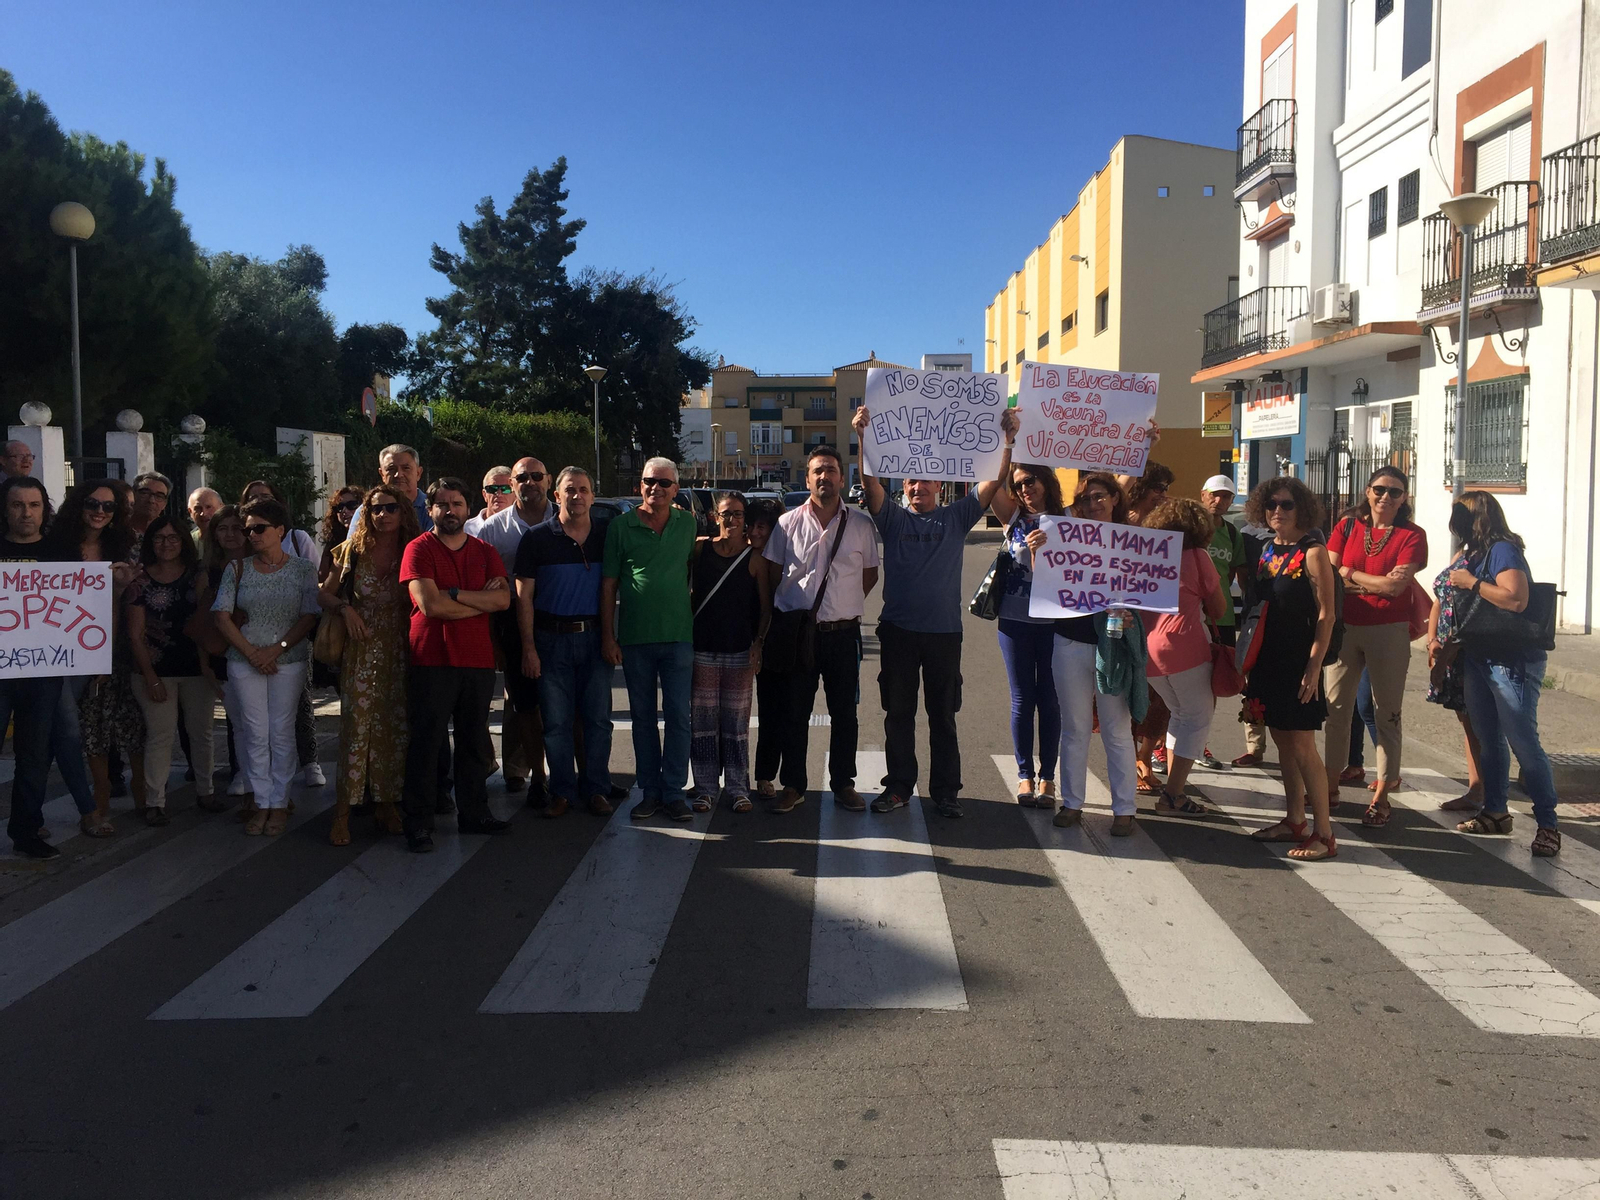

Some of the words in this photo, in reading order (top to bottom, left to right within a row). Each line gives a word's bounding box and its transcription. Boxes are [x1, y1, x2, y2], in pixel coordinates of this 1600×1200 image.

[885, 370, 919, 397] NO
[920, 372, 1000, 407] SOMOS
[1067, 367, 1157, 395] Educación
[1062, 391, 1081, 403] es
[1246, 382, 1295, 413] LAURA
[1040, 398, 1108, 425] Vacuna
[870, 401, 1000, 453] ENEMIGOS
[1057, 420, 1121, 440] contra
[908, 442, 933, 456] DE
[878, 455, 976, 478] NADIE
[1057, 521, 1107, 549] PAPÁ,
[1110, 529, 1174, 559] MAMÁ
[1042, 549, 1103, 568] TODOS
[1108, 557, 1178, 580] ESTAMOS
[2, 568, 106, 595] MERECEMOS
[1063, 569, 1084, 584] EN
[1090, 572, 1107, 585] EL
[1110, 574, 1159, 595] MISMO
